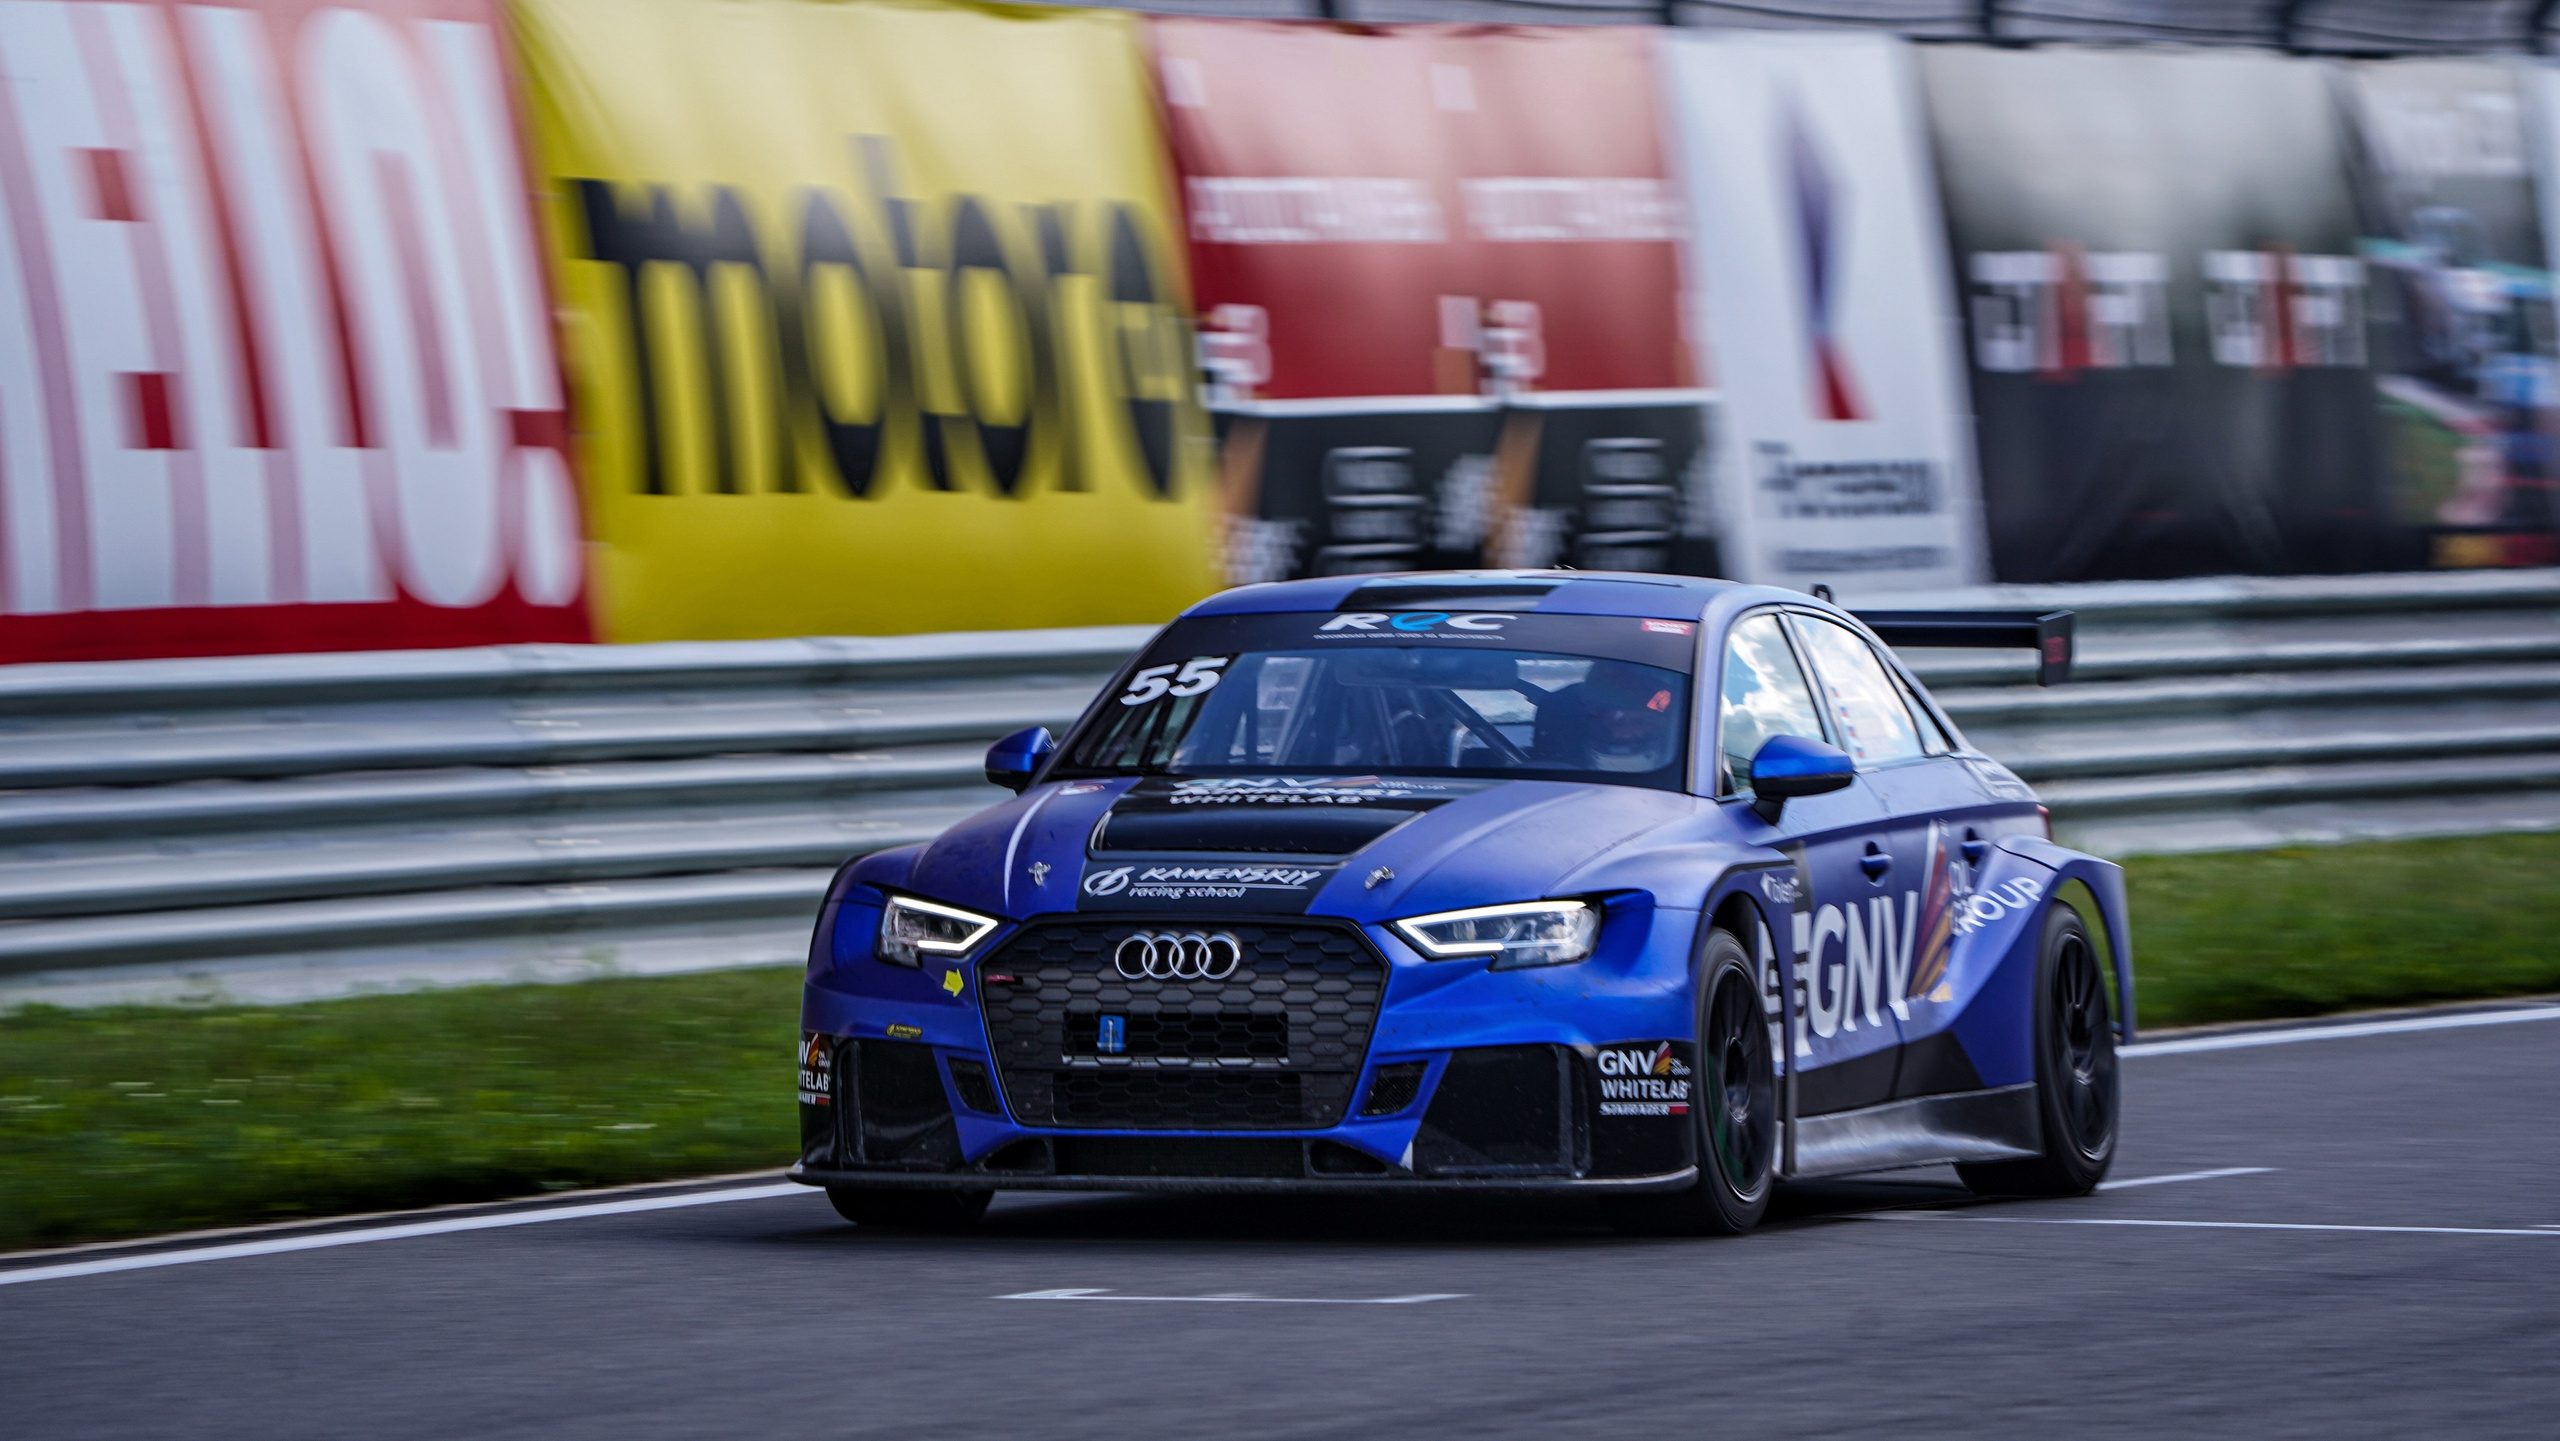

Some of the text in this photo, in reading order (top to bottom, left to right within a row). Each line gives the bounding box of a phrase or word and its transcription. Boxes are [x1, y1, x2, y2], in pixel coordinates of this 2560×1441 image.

[1120, 657, 1229, 706] 55
[1139, 866, 1322, 886] KAMENSKIY
[1128, 885, 1247, 899] racing school
[1598, 1050, 1657, 1076] GNV
[1600, 1079, 1688, 1099] WHITELAB
